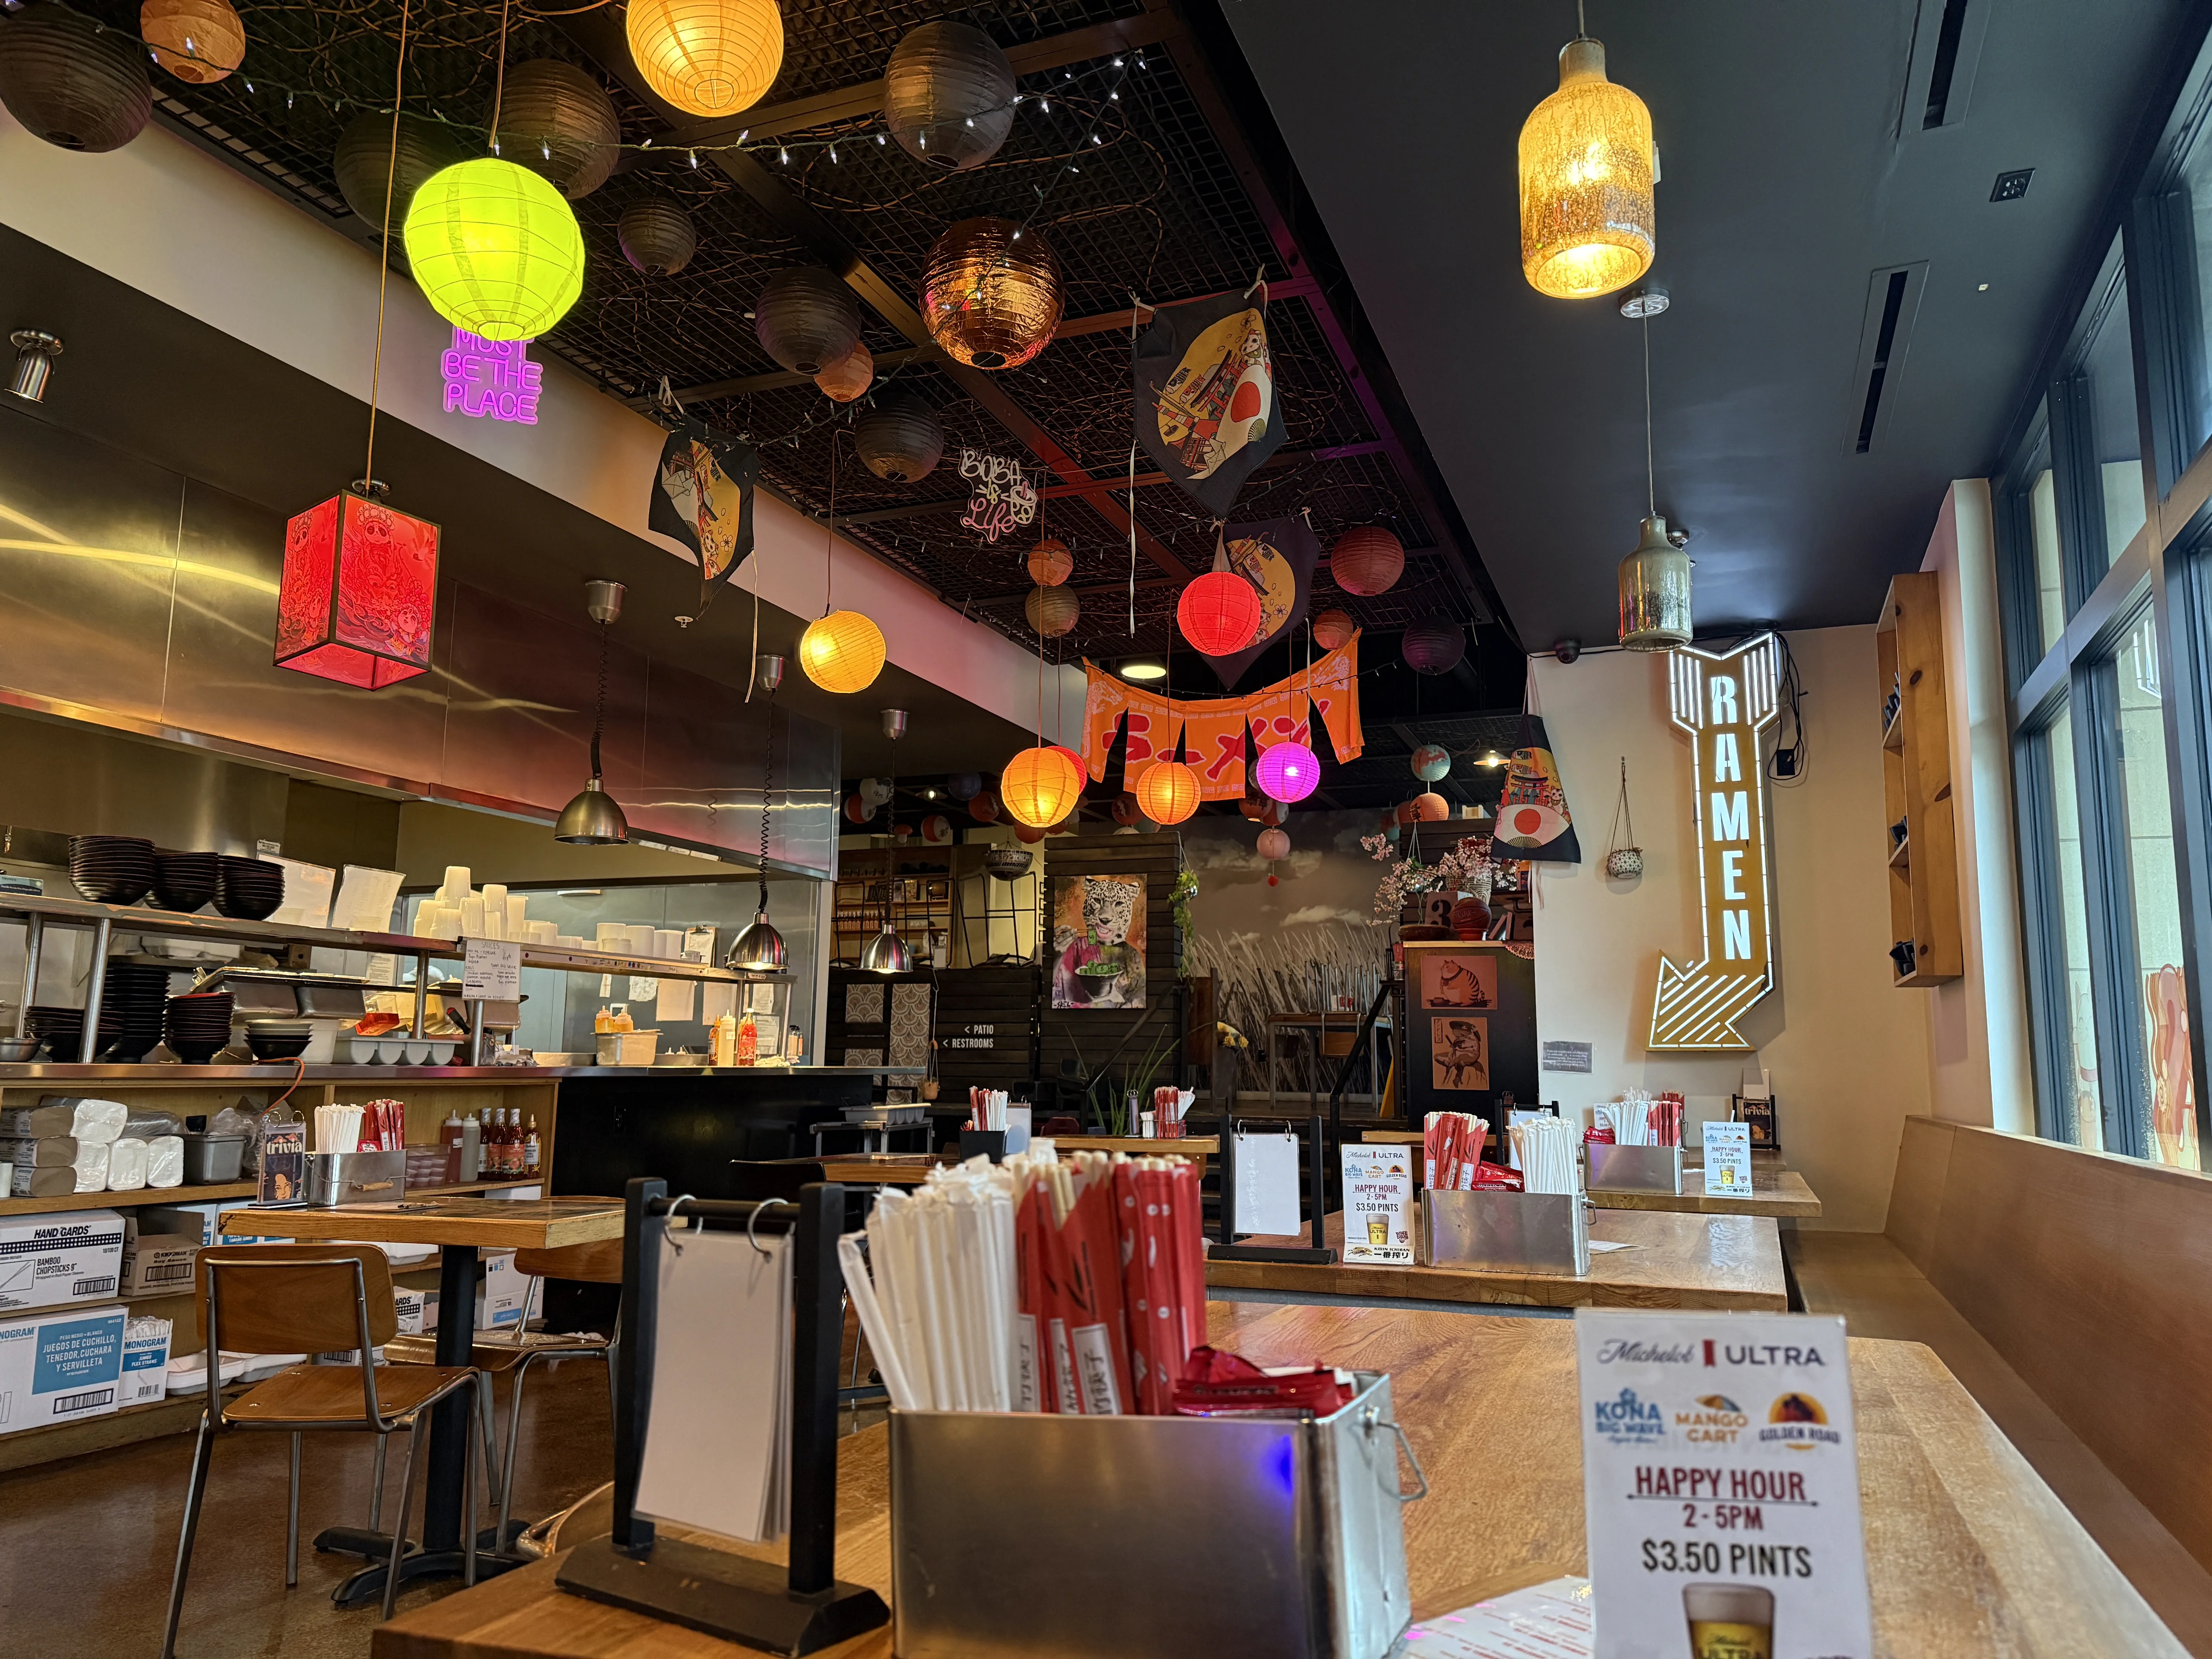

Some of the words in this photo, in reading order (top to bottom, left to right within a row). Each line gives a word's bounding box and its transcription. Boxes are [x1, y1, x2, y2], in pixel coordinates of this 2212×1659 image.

[445, 352, 481, 381] BE
[484, 357, 541, 391] THE
[447, 383, 536, 421] PLACE
[961, 449, 1022, 486] BOBA
[963, 498, 1016, 541] Life
[1711, 676, 1751, 960] RAMEN
[974, 1025, 994, 1034] PATIO
[952, 1039, 993, 1048] RESTROOMS
[267, 1141, 302, 1154] trivia
[1355, 1184, 1377, 1192] HAPPY
[1356, 1202, 1376, 1211] $3.50
[1378, 1204, 1398, 1212] PINTS
[36, 1264, 69, 1275] CHOPSTICKS
[38, 1257, 60, 1266] BAMBOO
[43, 1341, 70, 1353] JUEGOS
[82, 1334, 116, 1347] CUCHILLO,
[124, 1337, 166, 1349] MONOGRAM
[1725, 1345, 1825, 1366] ULTRA
[56, 1364, 61, 1372] Y
[62, 1357, 102, 1371] SERVILLETA
[1595, 1401, 1661, 1420] KONA
[1675, 1413, 1748, 1427] MANGO
[1687, 1429, 1738, 1443] CART
[1759, 1428, 1807, 1442] GOLDEN
[1809, 1428, 1840, 1444] ROAD
[1636, 1466, 1722, 1497] HAPPY
[1731, 1470, 1806, 1501] HOUR
[1682, 1504, 1697, 1527] 2
[1715, 1505, 1764, 1530] 5PM
[1642, 1539, 1720, 1574] $3.50
[1731, 1544, 1813, 1578] PINTS
